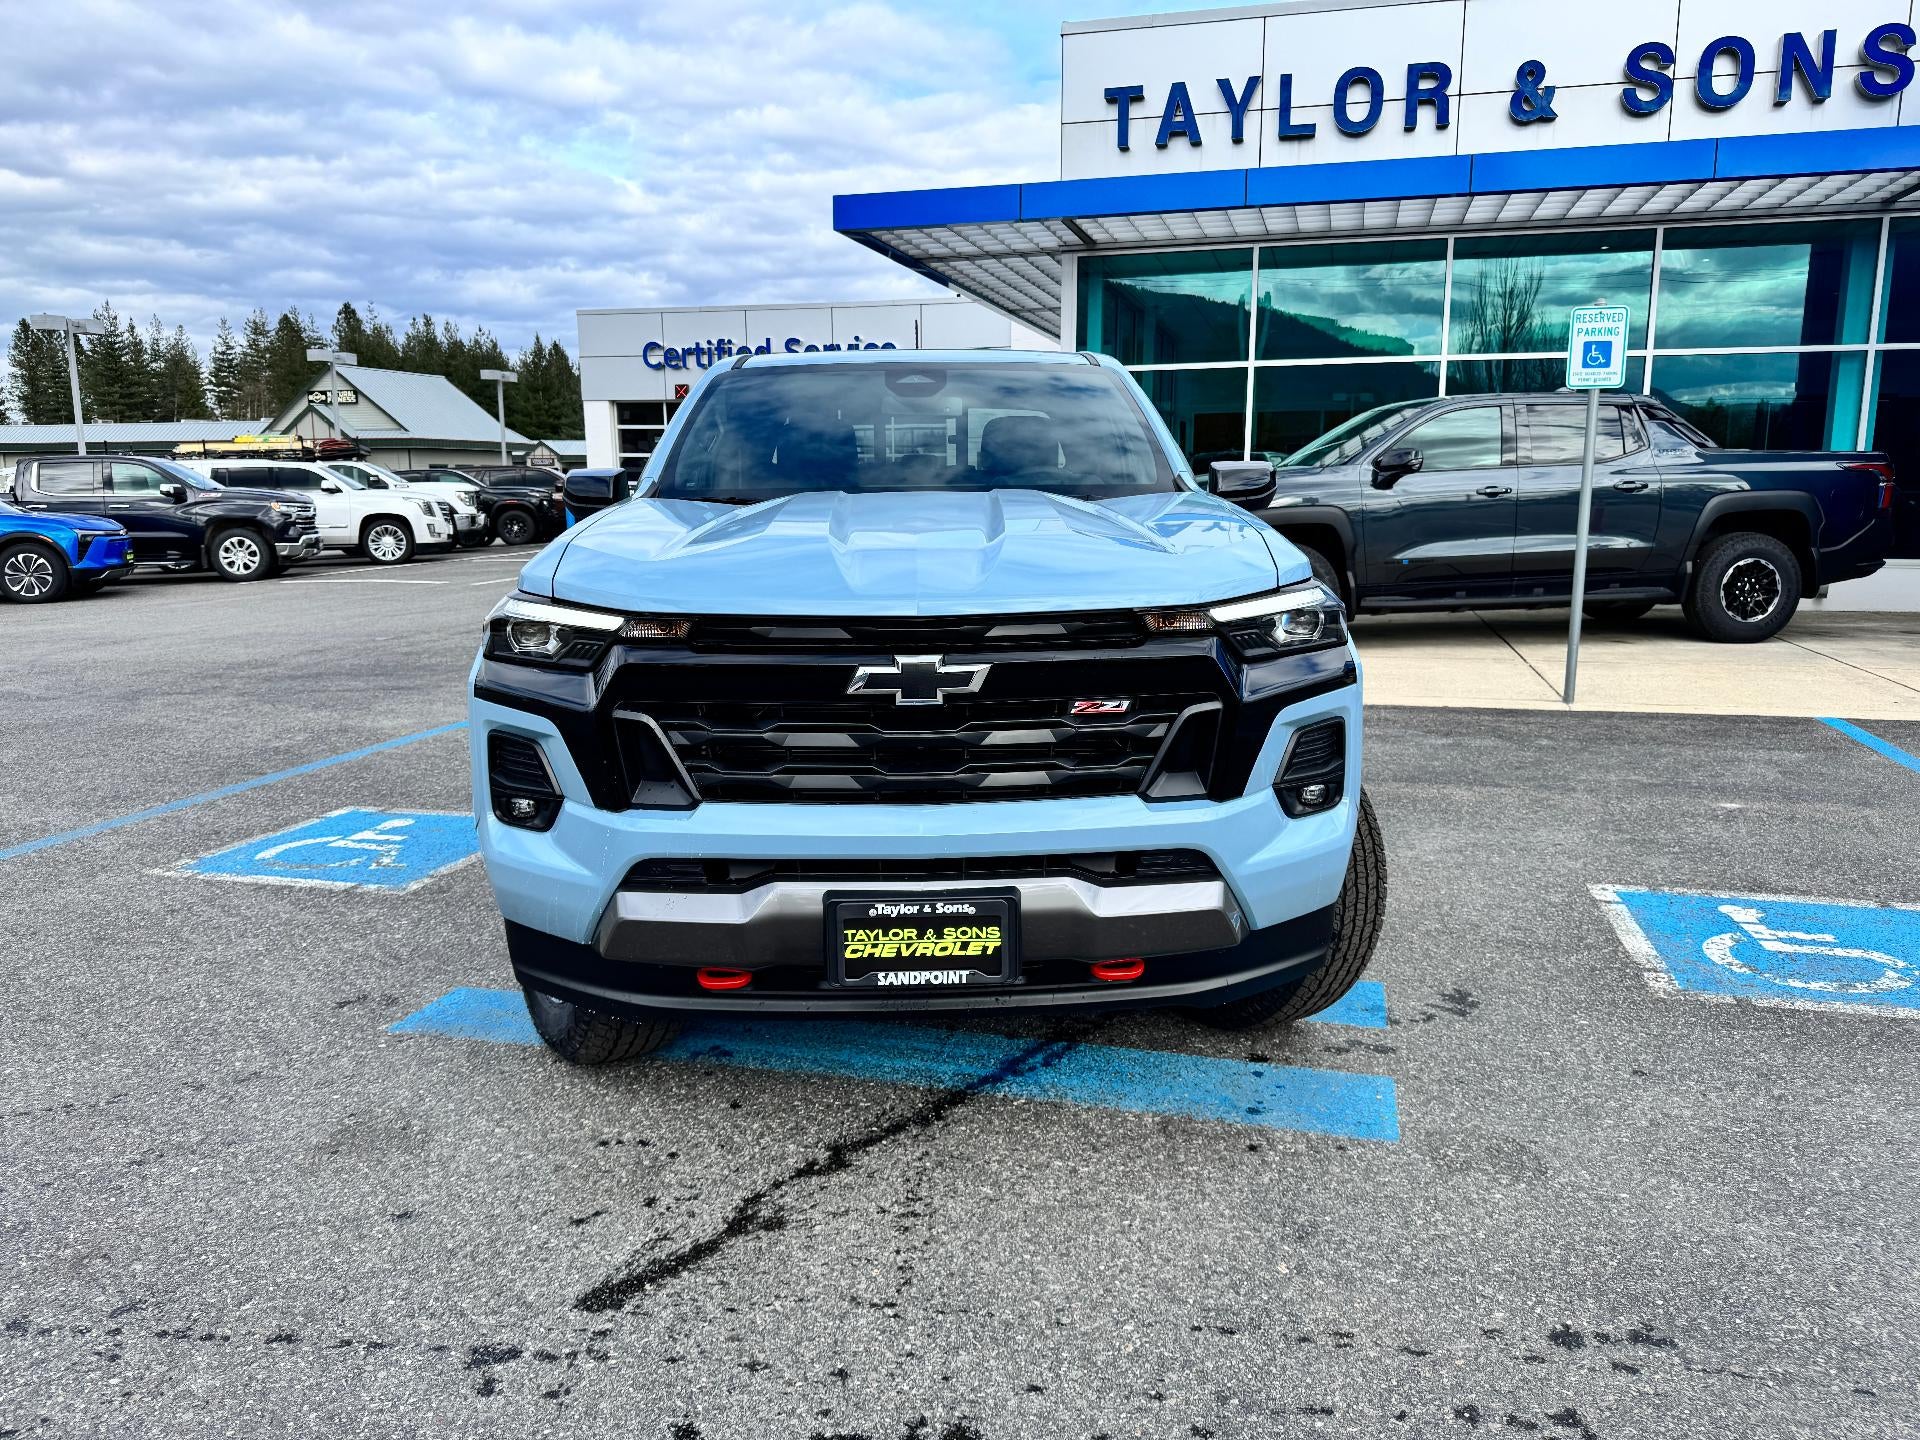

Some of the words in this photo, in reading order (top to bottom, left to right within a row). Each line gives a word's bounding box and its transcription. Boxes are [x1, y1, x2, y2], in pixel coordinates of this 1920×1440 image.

[1104, 61, 1453, 151] TAYLOR
[1509, 60, 1559, 126] &
[1620, 23, 1917, 118] SONS
[1575, 312, 1624, 324] RESERVED
[1576, 326, 1620, 337] PARKING
[875, 903, 919, 917] Taylor
[923, 905, 932, 913] &
[935, 902, 969, 913] Sons
[844, 929, 918, 941] TAYLOR
[923, 928, 937, 941] &
[943, 926, 1000, 940] SONS
[844, 941, 1001, 958] CHEVROLET
[877, 971, 970, 986] SANDPOINT
